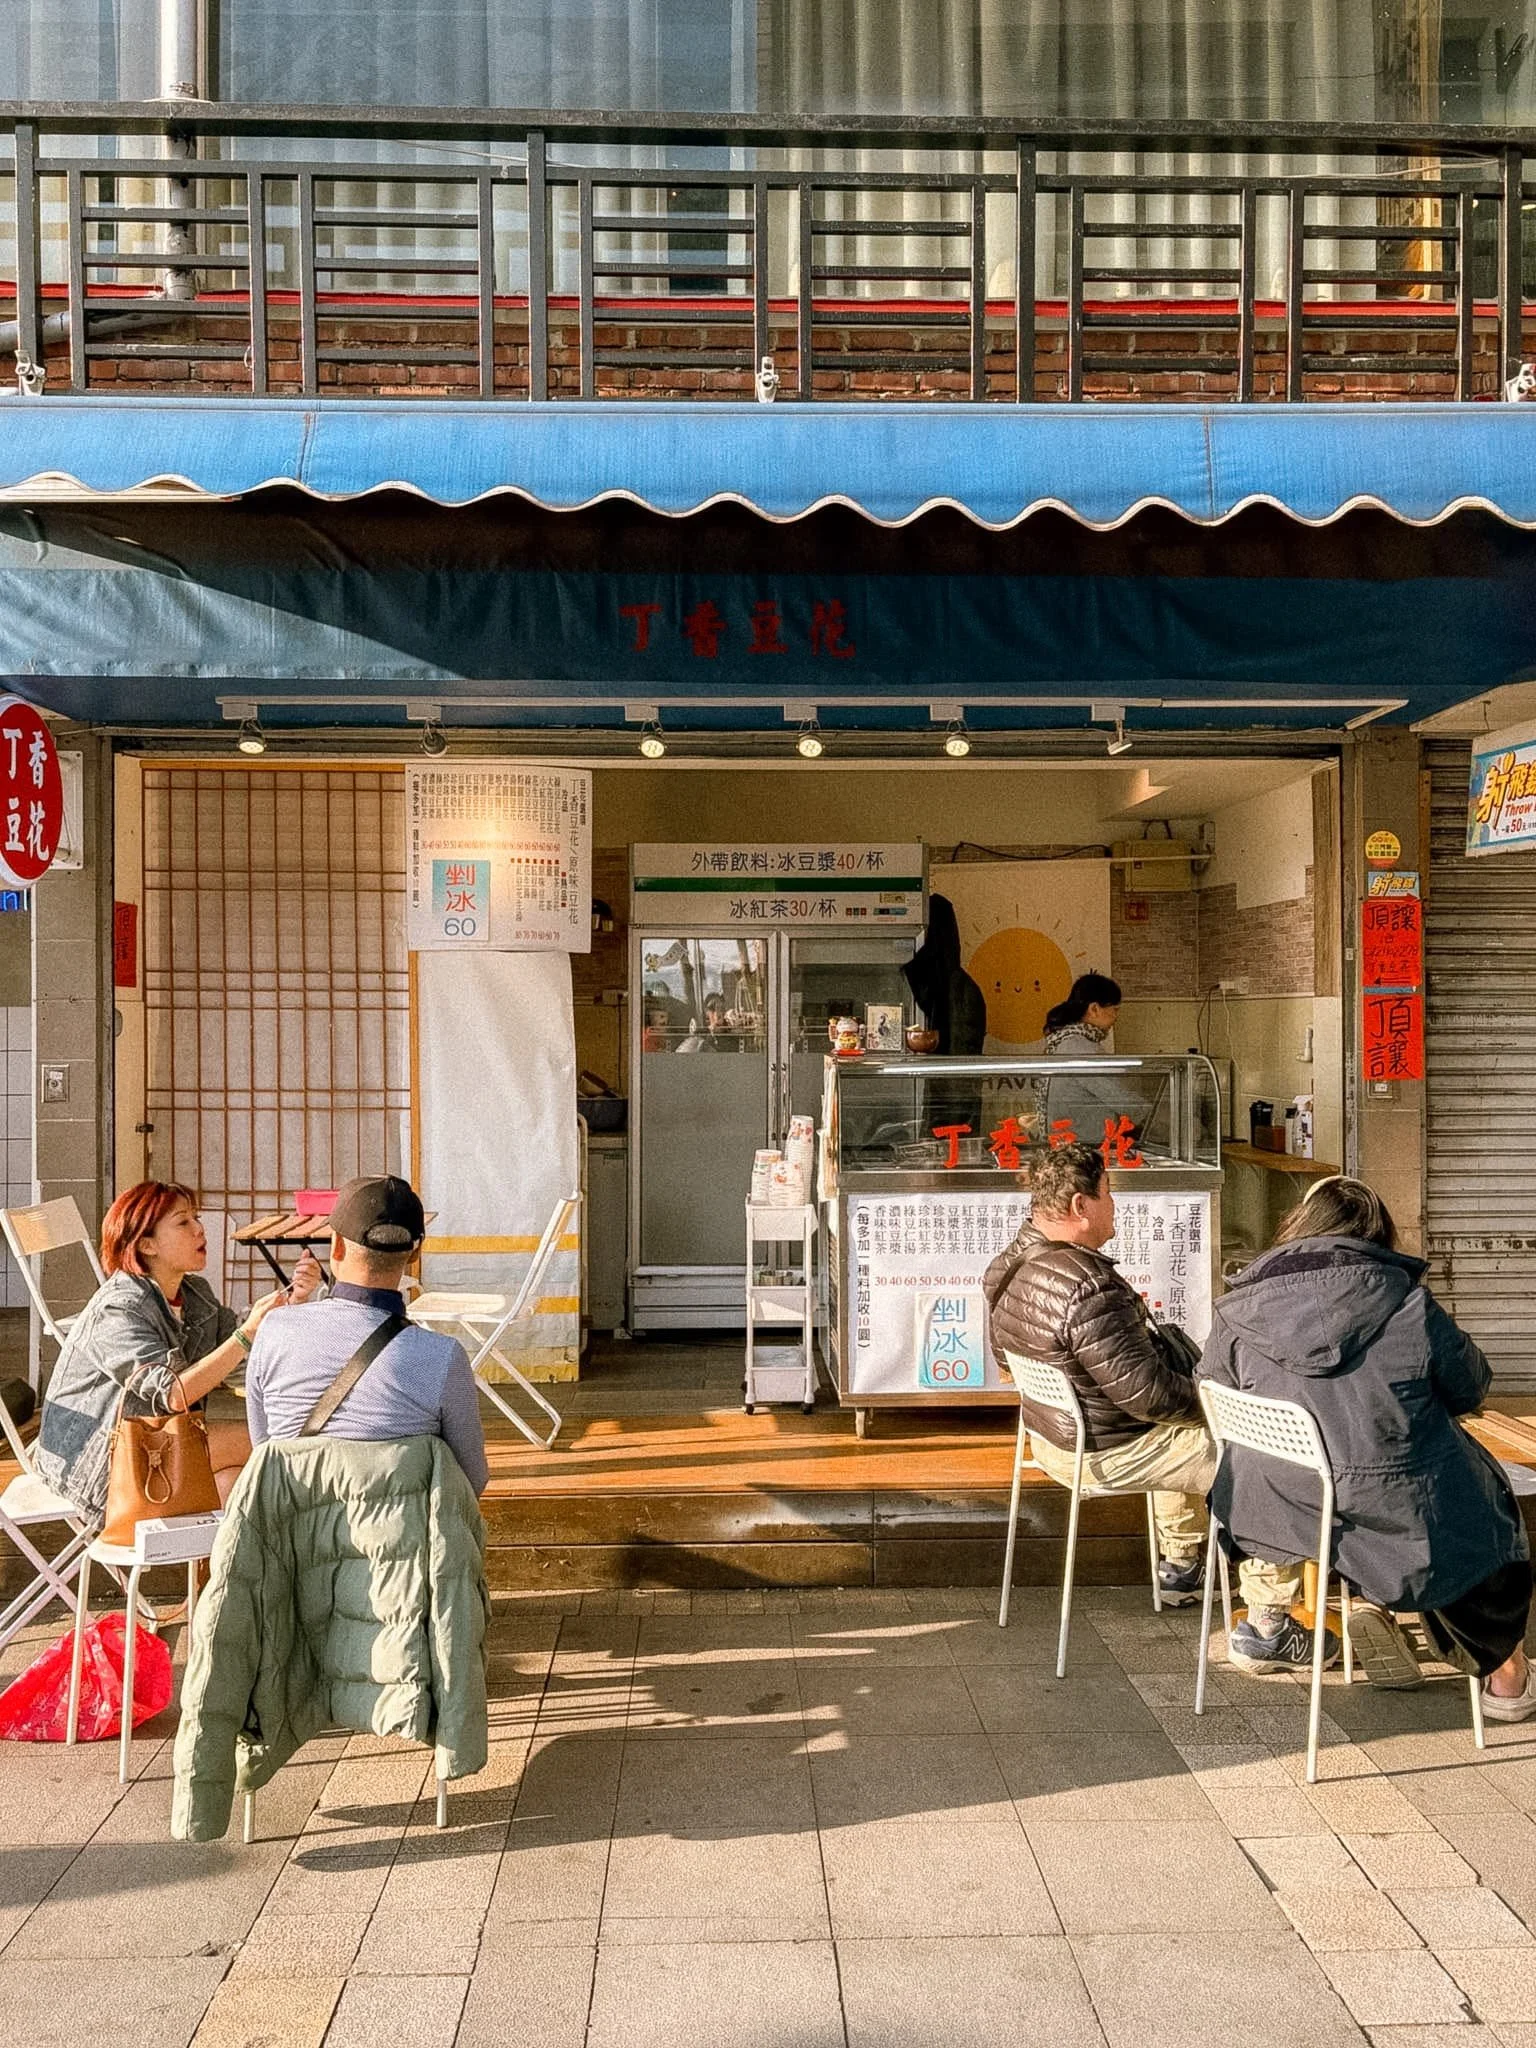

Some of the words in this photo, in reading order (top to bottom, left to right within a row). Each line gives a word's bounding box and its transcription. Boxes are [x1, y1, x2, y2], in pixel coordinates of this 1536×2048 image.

[618, 599, 856, 658] 丁香豆花
[3, 728, 47, 789] 丁香
[1505, 803, 1533, 817] Throw
[5, 797, 49, 861] 豆花
[692, 851, 884, 872] 外帶飲料:冰豆漿40/杯
[445, 864, 476, 912] 剉冰
[730, 899, 837, 919] 冰紅茶30/杯
[1366, 905, 1417, 931] 頂讓
[445, 918, 476, 936] 60
[874, 1276, 887, 1286] 30
[889, 1276, 902, 1286] 40
[904, 1276, 917, 1286] 60
[919, 1276, 931, 1286] 50
[933, 1276, 946, 1286] 50
[948, 1276, 960, 1286] 40
[963, 1276, 975, 1286] 60
[1139, 1275, 1151, 1284] 60
[932, 1296, 968, 1353] 剉冰
[932, 1360, 969, 1381] 60
